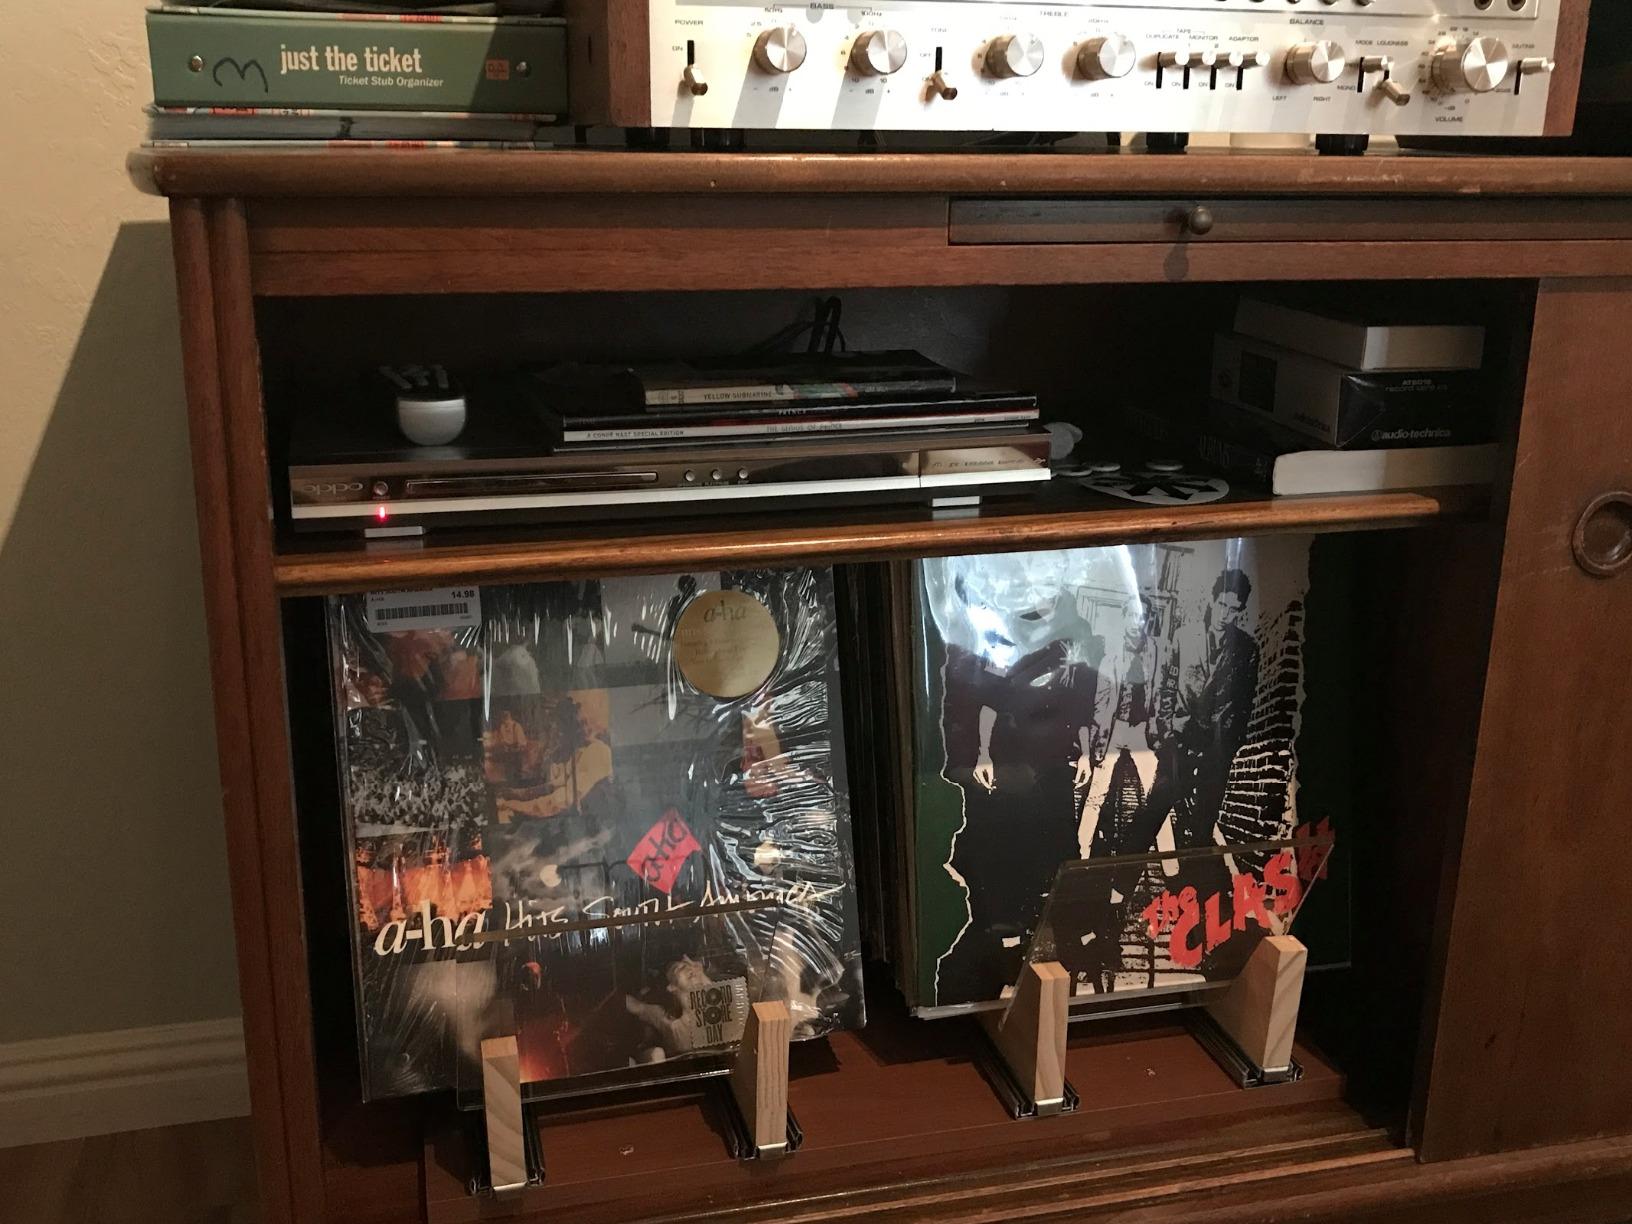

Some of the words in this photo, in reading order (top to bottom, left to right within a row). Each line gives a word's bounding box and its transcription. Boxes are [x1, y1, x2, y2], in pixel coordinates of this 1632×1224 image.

[809, 2, 835, 10] BASS
[1289, 18, 1325, 26] BALANCE
[280, 44, 320, 75] just
[325, 45, 359, 72] the
[364, 47, 423, 74] ticket
[338, 75, 369, 86] Ticket
[370, 76, 395, 87] Stub
[395, 77, 445, 89] Organizer
[1435, 115, 1464, 123] VOLUME
[1381, 427, 1452, 440] audio-technica
[703, 599, 747, 624] a-ha
[373, 899, 487, 957] a-ha
[689, 984, 734, 1011] RECORD
[695, 1003, 734, 1028] STORE
[706, 1023, 724, 1044] DAY
